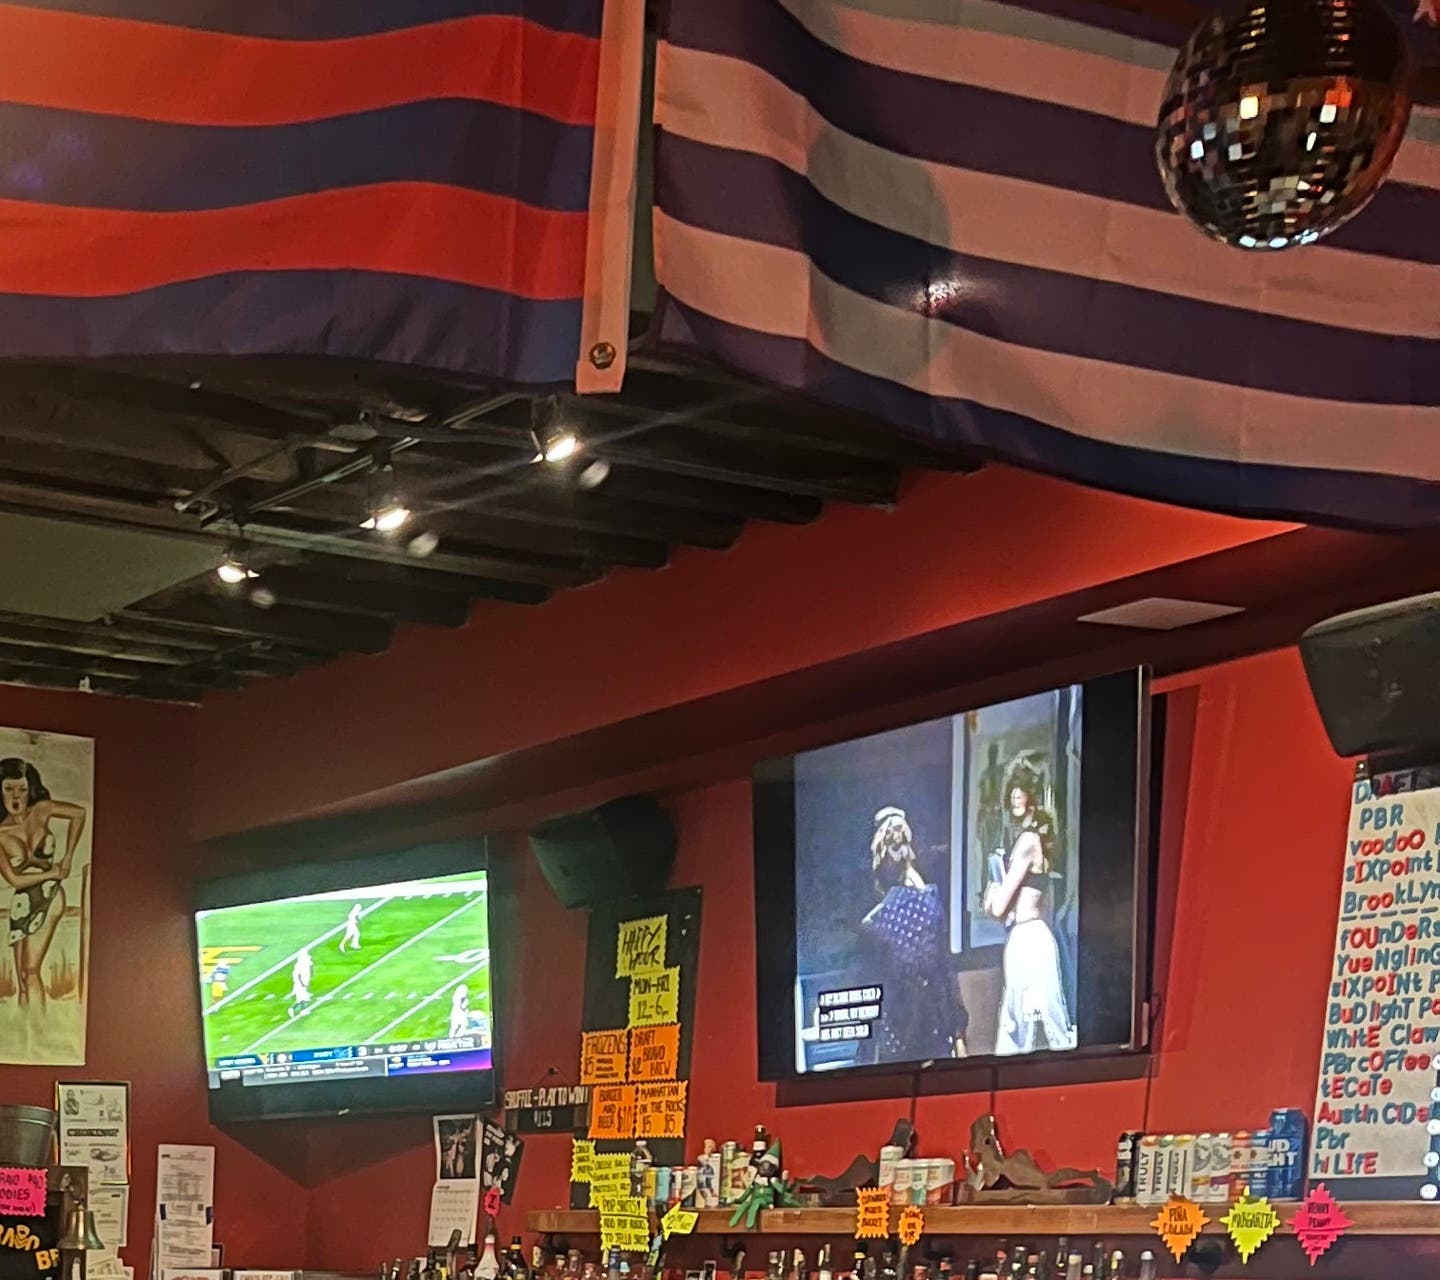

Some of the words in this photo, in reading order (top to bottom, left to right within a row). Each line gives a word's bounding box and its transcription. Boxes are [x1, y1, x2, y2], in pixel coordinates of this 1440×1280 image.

[1359, 804, 1404, 831] PBR
[621, 922, 663, 956] HAPPY
[1329, 1001, 1368, 1025] BuD
[585, 1034, 625, 1056] FROZENS
[504, 1089, 533, 1110] SHUFFLE
[538, 1087, 557, 1107] PLAY
[557, 1086, 567, 1106] TO
[640, 1086, 680, 1100] MANHATTAN
[650, 1101, 664, 1113] THE
[1138, 1151, 1151, 1193] TRULY
[1231, 1211, 1274, 1229] MARGARITA
